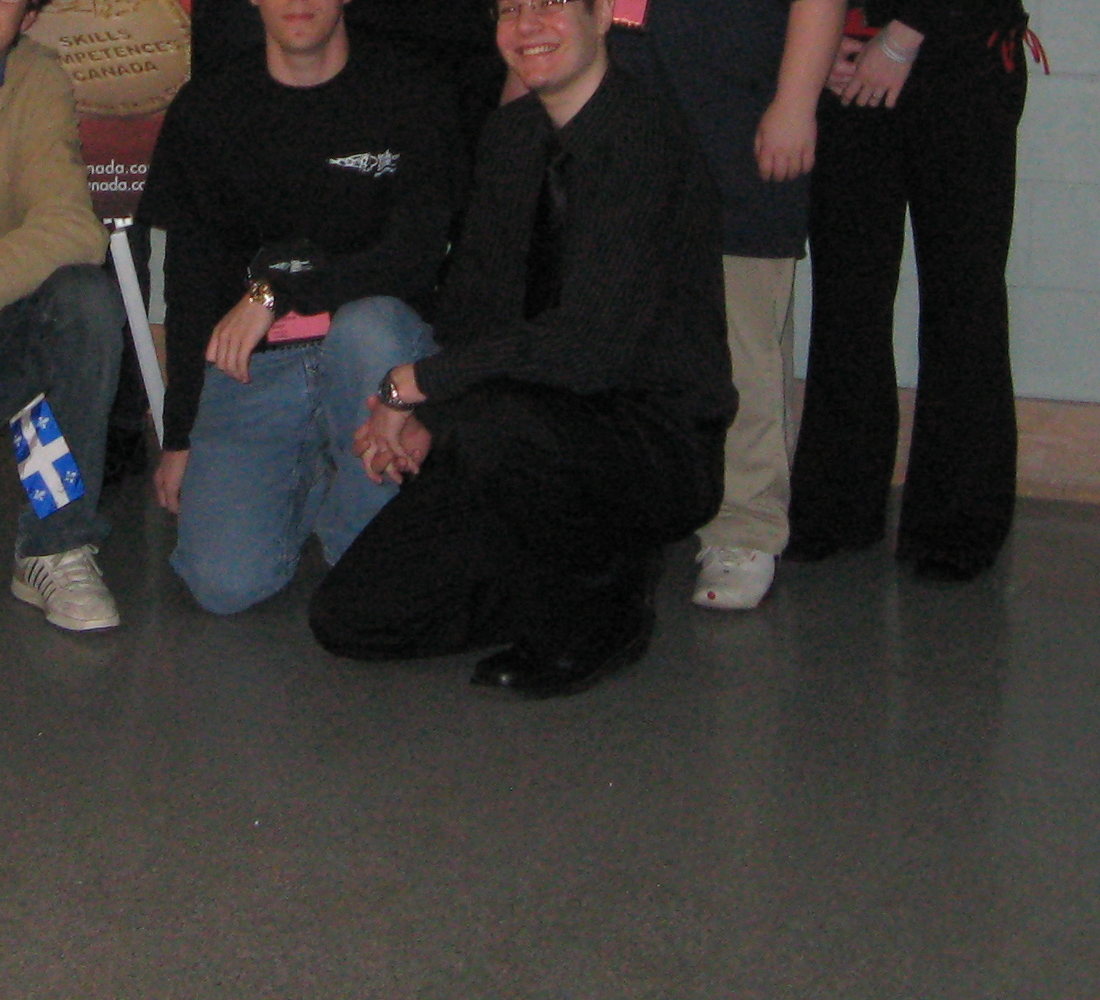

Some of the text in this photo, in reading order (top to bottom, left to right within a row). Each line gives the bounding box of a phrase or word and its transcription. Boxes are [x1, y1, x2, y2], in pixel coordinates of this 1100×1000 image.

[60, 28, 131, 47] SKILLS
[57, 39, 182, 65] MPETENCES
[73, 61, 160, 82] CANADA
